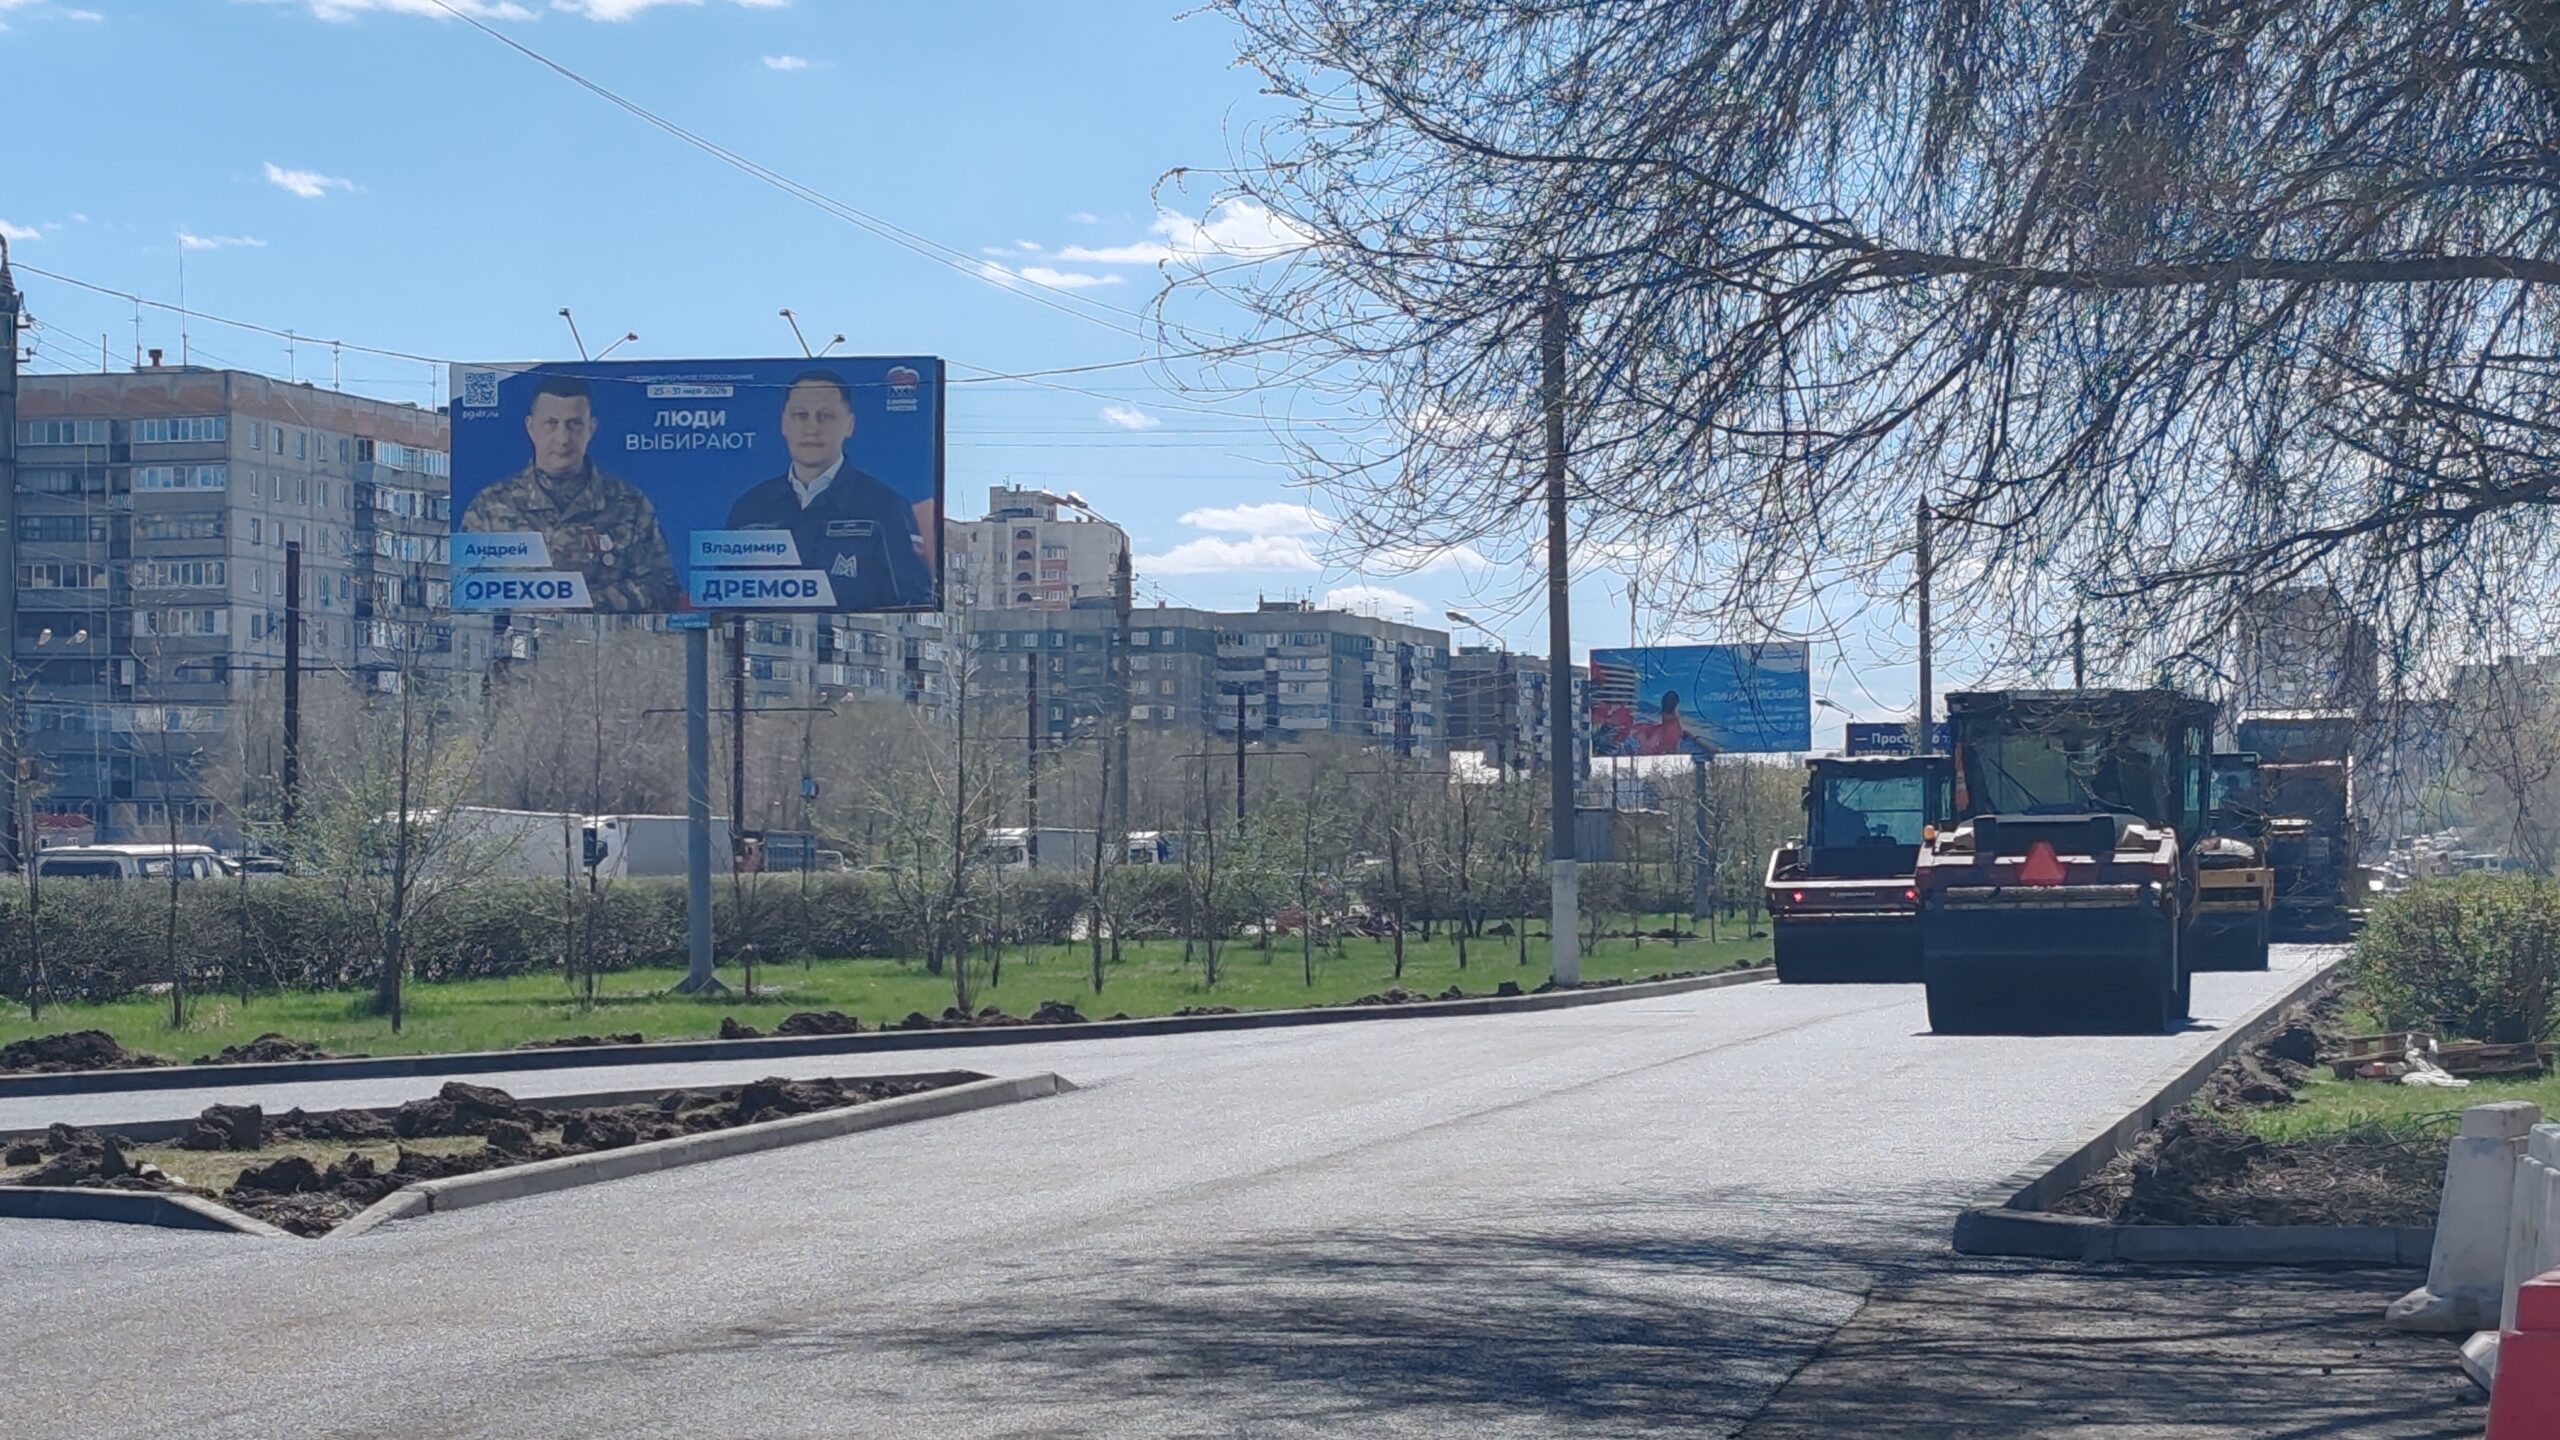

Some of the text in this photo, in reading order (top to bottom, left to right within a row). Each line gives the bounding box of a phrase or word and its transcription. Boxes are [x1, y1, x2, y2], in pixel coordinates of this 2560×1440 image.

[654, 410, 726, 429] ЛЮДИ
[626, 432, 757, 450] ВЫБИРАЮТ
[465, 542, 528, 558] Андрей
[702, 541, 787, 556] Владимир
[465, 580, 573, 600] ОРЕХОВ
[702, 578, 818, 601] ДРЕМОВ
